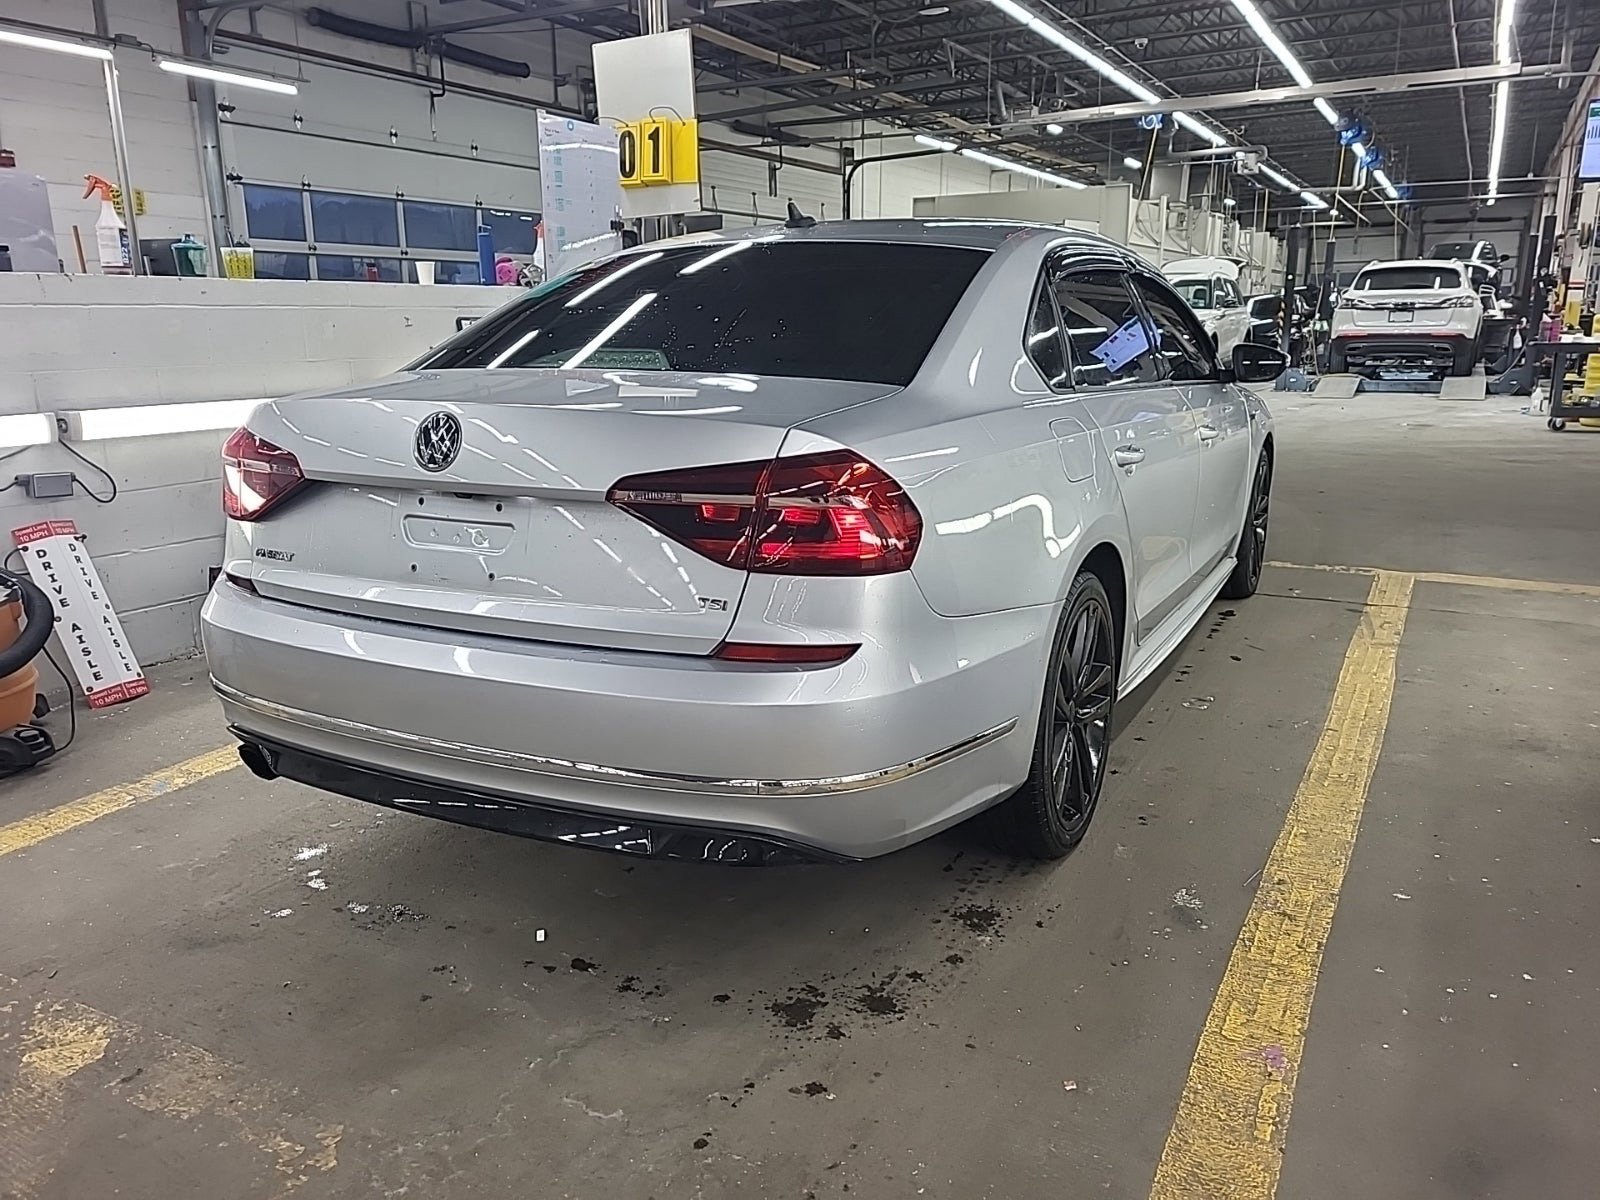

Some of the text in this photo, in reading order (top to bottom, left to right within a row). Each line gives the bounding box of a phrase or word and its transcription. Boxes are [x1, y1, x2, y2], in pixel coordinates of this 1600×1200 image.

[29, 530, 49, 540] MPH
[35, 549, 70, 608] DRIVE
[71, 622, 104, 682] AISLE
[68, 543, 132, 672] DRIVE AISLE
[698, 597, 728, 611] TSI
